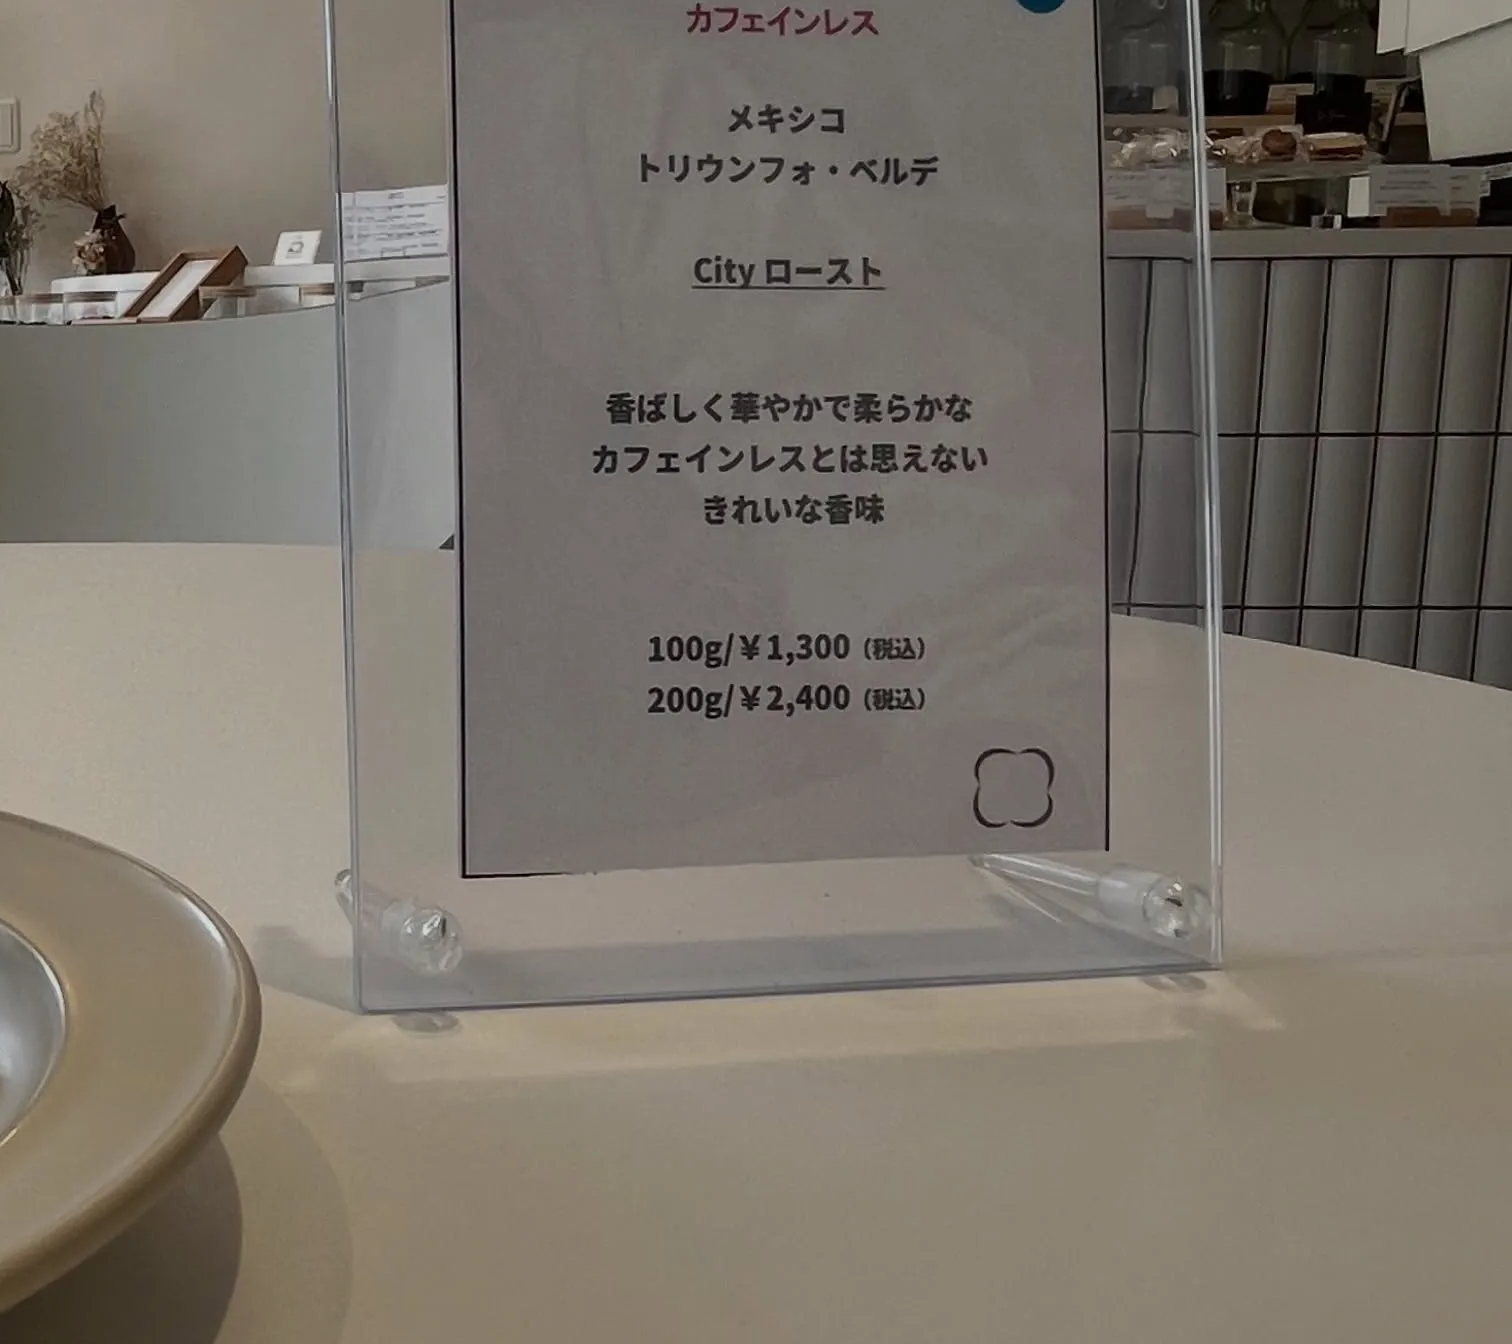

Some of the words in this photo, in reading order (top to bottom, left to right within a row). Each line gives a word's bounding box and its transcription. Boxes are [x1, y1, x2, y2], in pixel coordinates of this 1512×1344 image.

[686, 2, 880, 37] カフェインレス
[727, 103, 845, 135] メキシコ
[640, 154, 939, 187] トリウンフォ・ベルデ
[693, 256, 755, 287] City
[766, 256, 882, 286] ロースト
[605, 391, 973, 425] 香ばしく華やかで柔らかな
[592, 443, 989, 475] カフェインレスとは思えない
[703, 493, 885, 526] きれいな香味
